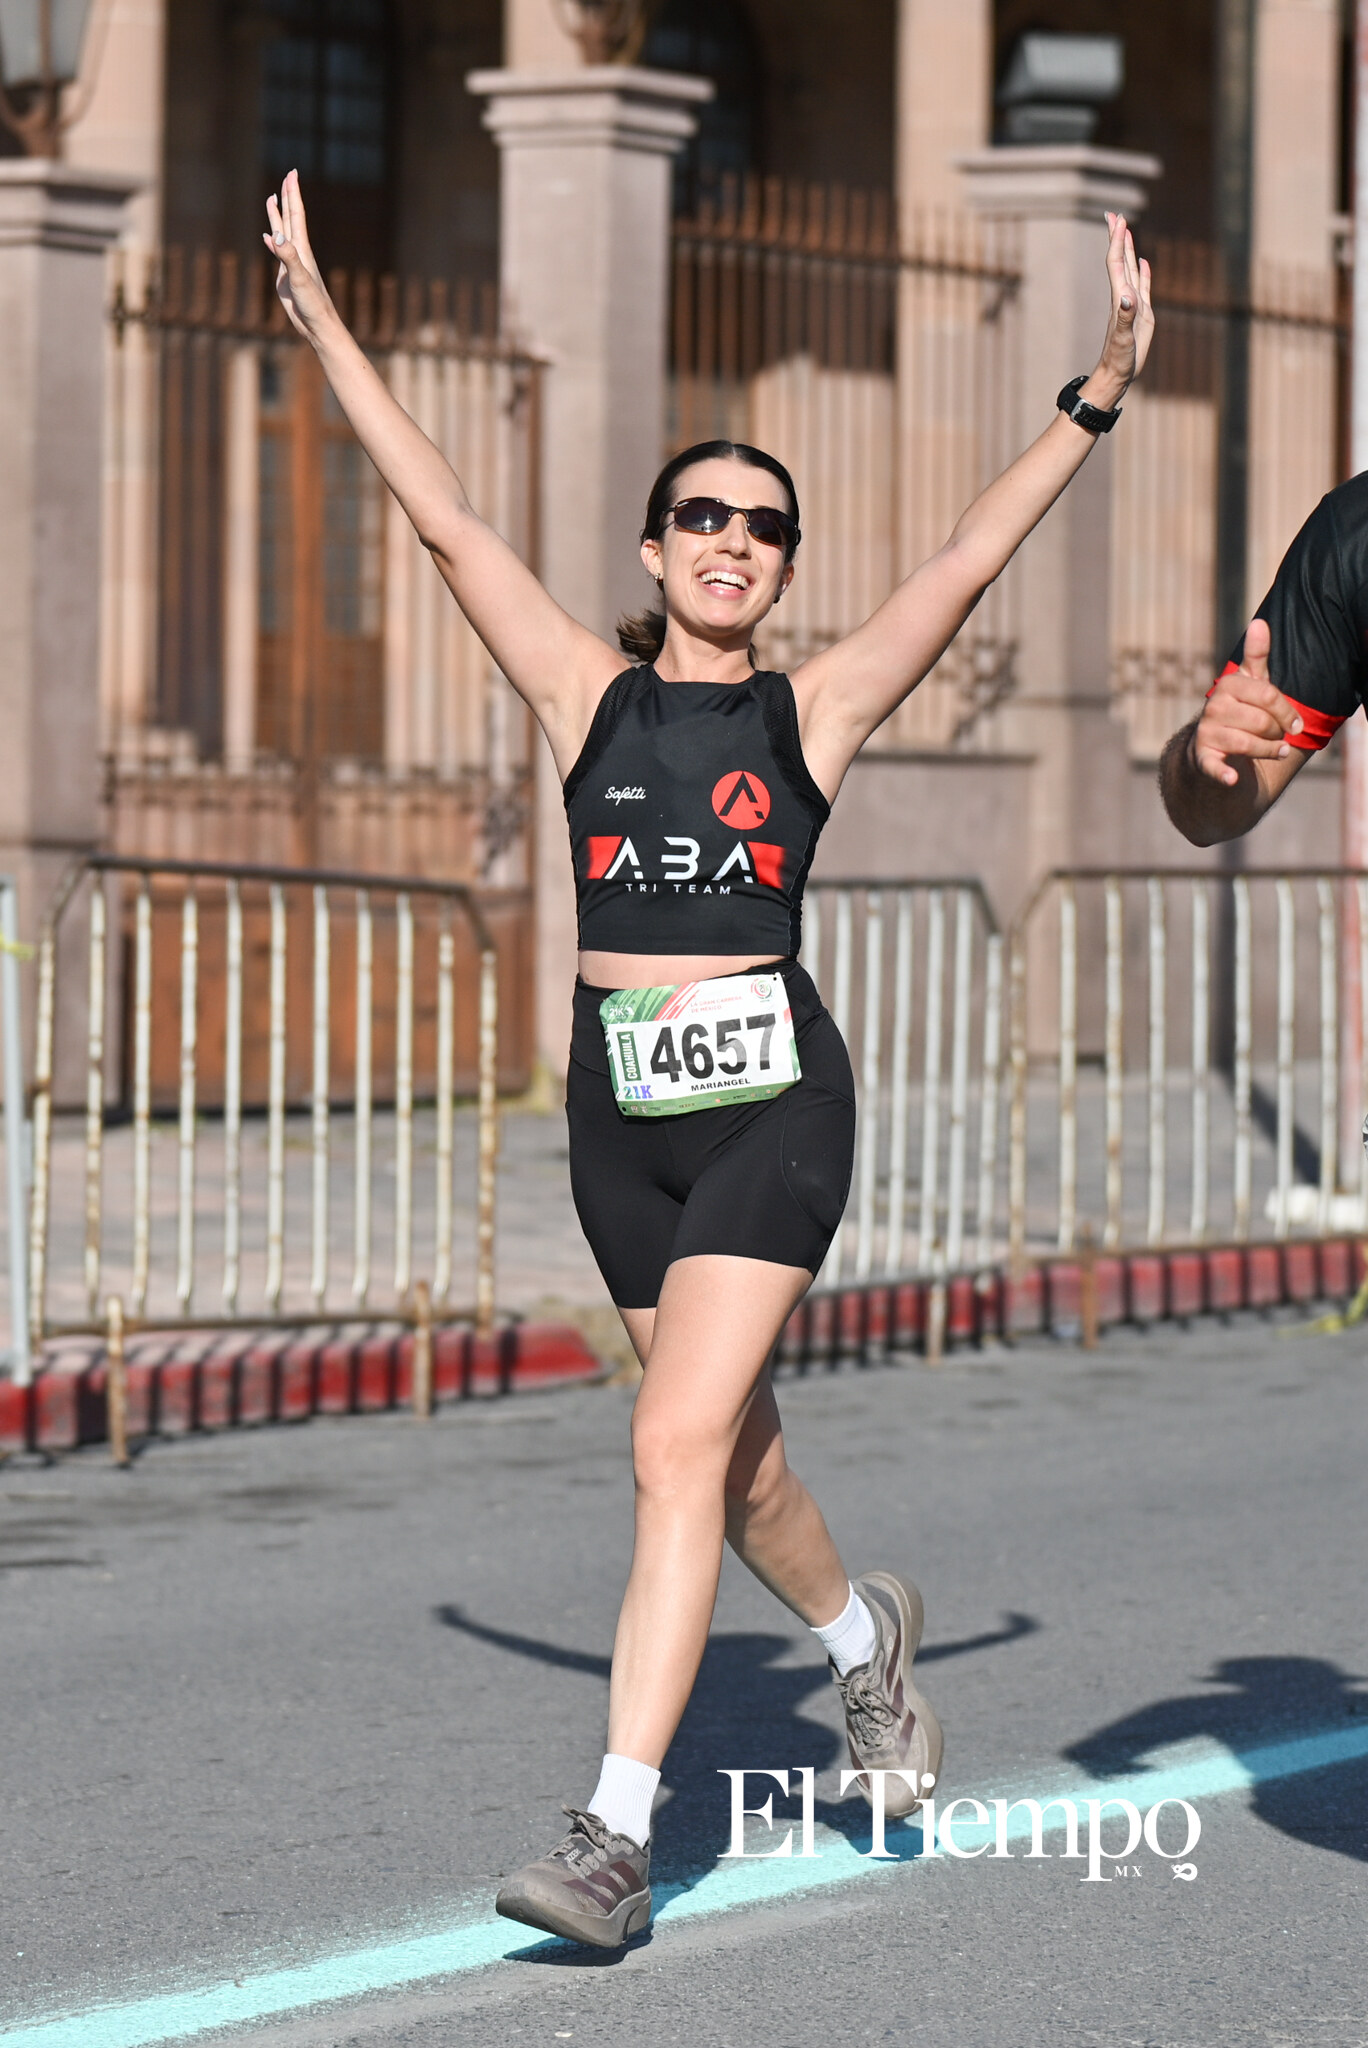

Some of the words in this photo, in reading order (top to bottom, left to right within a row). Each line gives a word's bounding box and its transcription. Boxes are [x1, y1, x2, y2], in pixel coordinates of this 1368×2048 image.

[605, 786, 647, 806] Safetti
[604, 836, 754, 884] ABA
[626, 883, 657, 893] TRI
[673, 883, 731, 895] TEAM
[623, 1033, 638, 1080] COAHUILA
[650, 1013, 776, 1083] 4657
[623, 1085, 653, 1100] 21K
[691, 1078, 751, 1092] MARIANGEL
